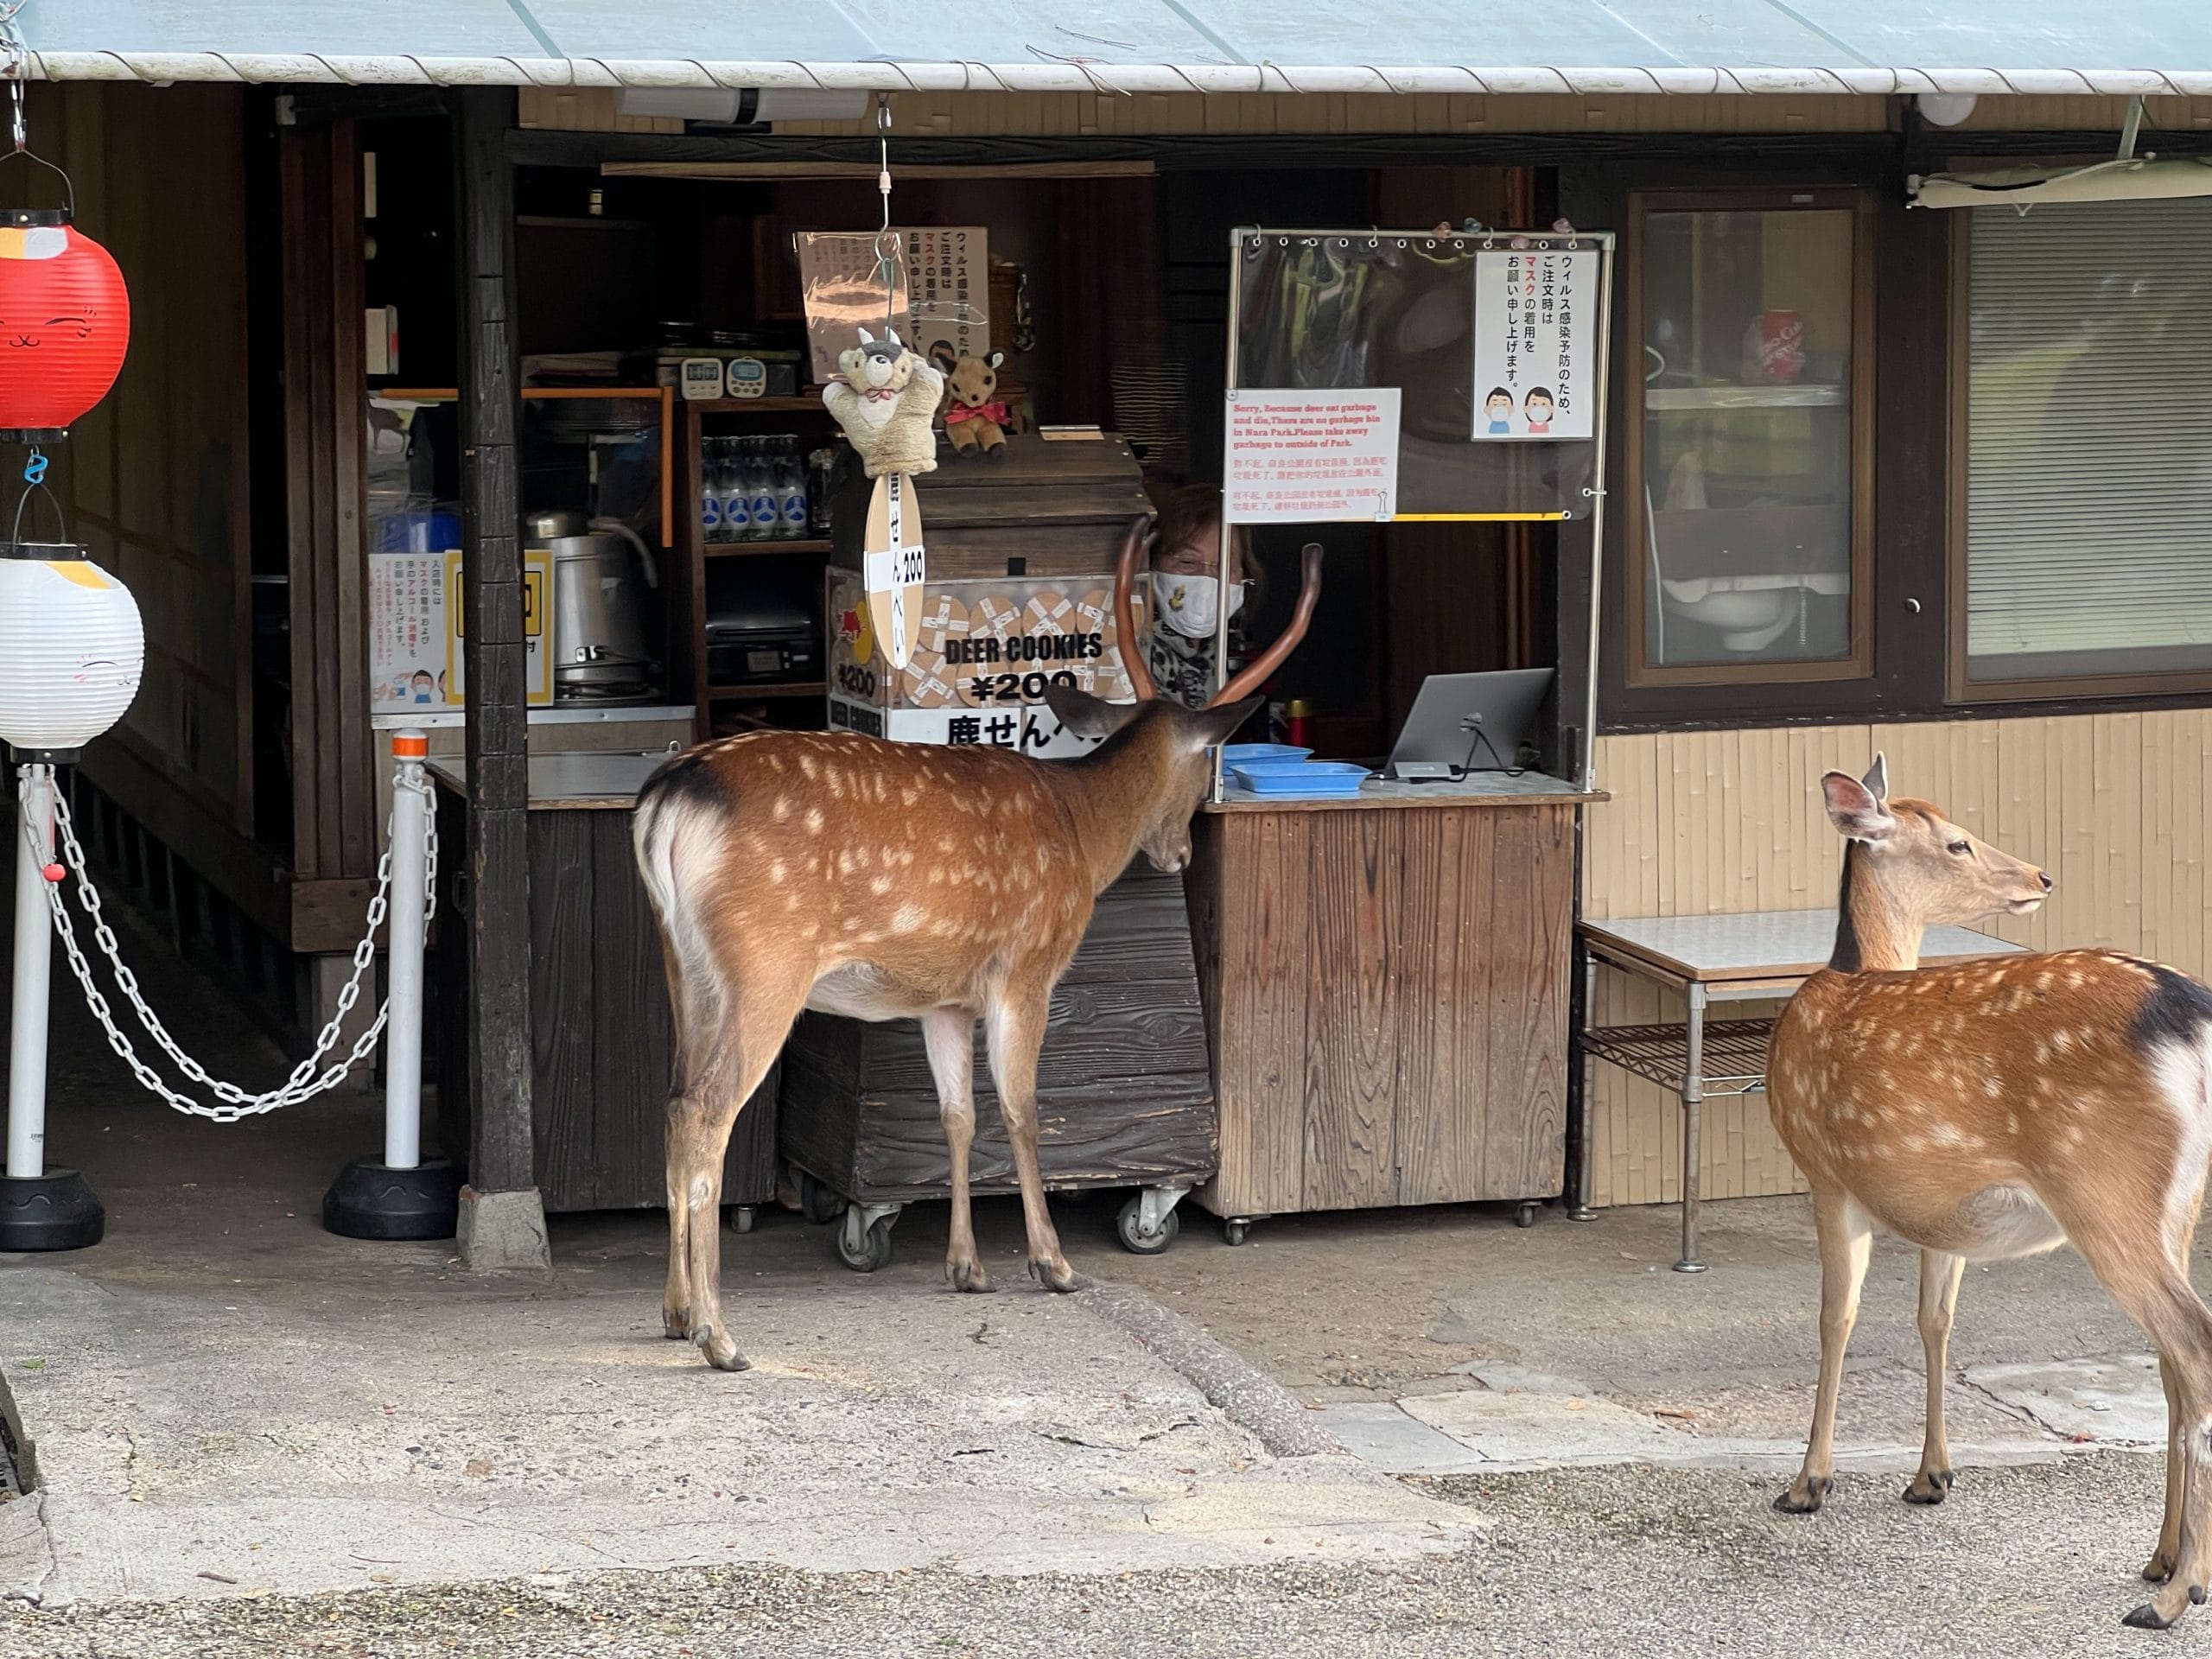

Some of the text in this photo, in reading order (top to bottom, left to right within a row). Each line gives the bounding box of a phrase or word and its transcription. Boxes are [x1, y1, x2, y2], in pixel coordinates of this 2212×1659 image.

[1524, 257, 1536, 353] マスクの着用を
[1542, 256, 1554, 324] ご注文時は
[1506, 256, 1519, 388] お願い申し上げます。
[1558, 256, 1573, 415] ウィルス感染予防のため、
[1233, 404, 1262, 414] Sorry,
[1341, 404, 1376, 413] garbage
[1329, 416, 1363, 425] garbage
[1233, 441, 1272, 449] garbage
[1320, 439, 1328, 448] of
[1345, 428, 1369, 436] away
[905, 550, 923, 583] 200
[945, 633, 1103, 664] DEER COOKIES
[838, 663, 875, 698] ¥200
